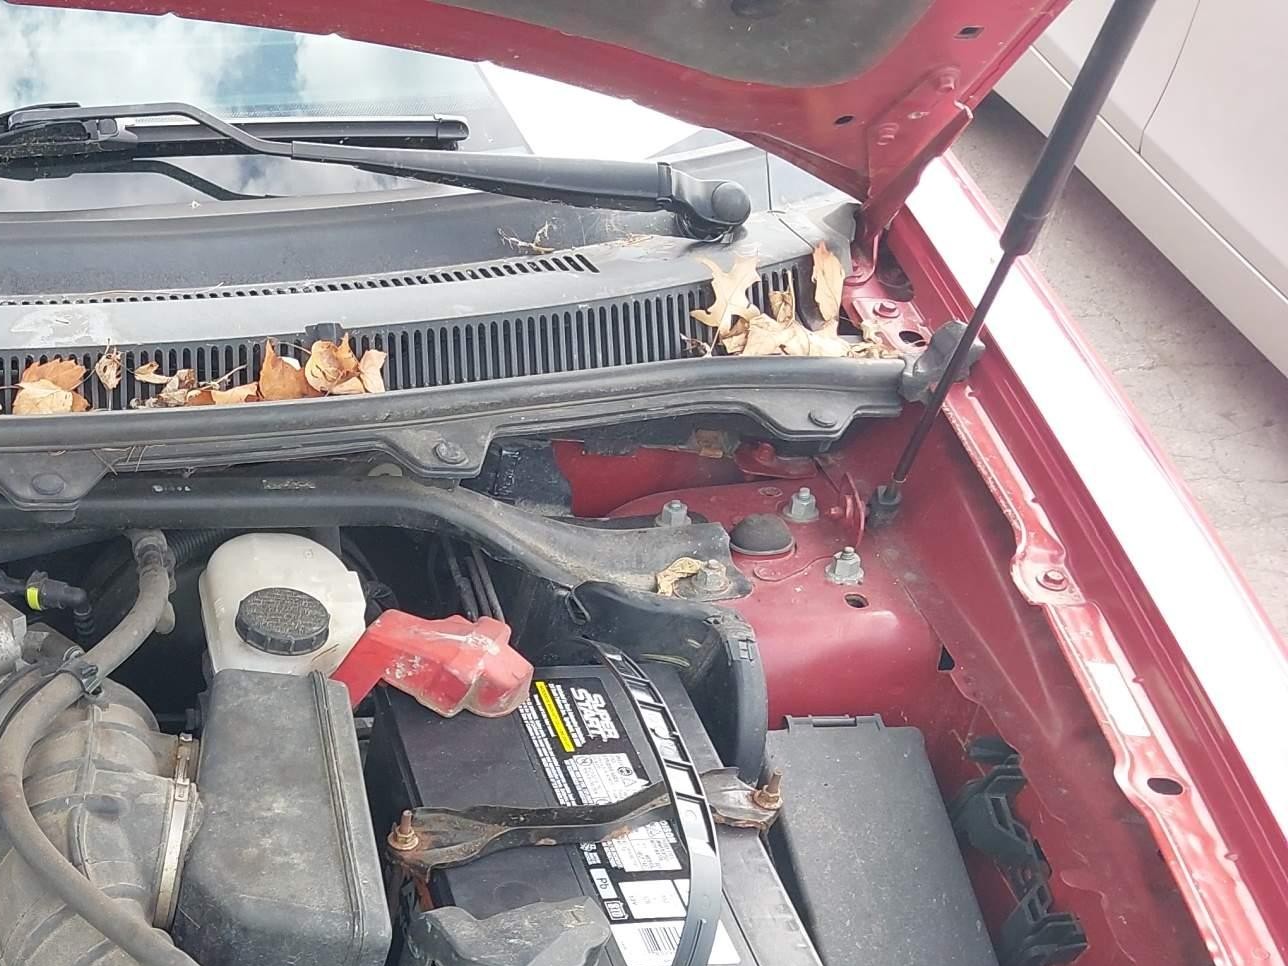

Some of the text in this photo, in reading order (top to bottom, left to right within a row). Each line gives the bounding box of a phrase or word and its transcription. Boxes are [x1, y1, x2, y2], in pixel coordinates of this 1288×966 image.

[572, 687, 606, 741] START
[590, 693, 620, 739] SUPER
[596, 877, 608, 890] Pb
